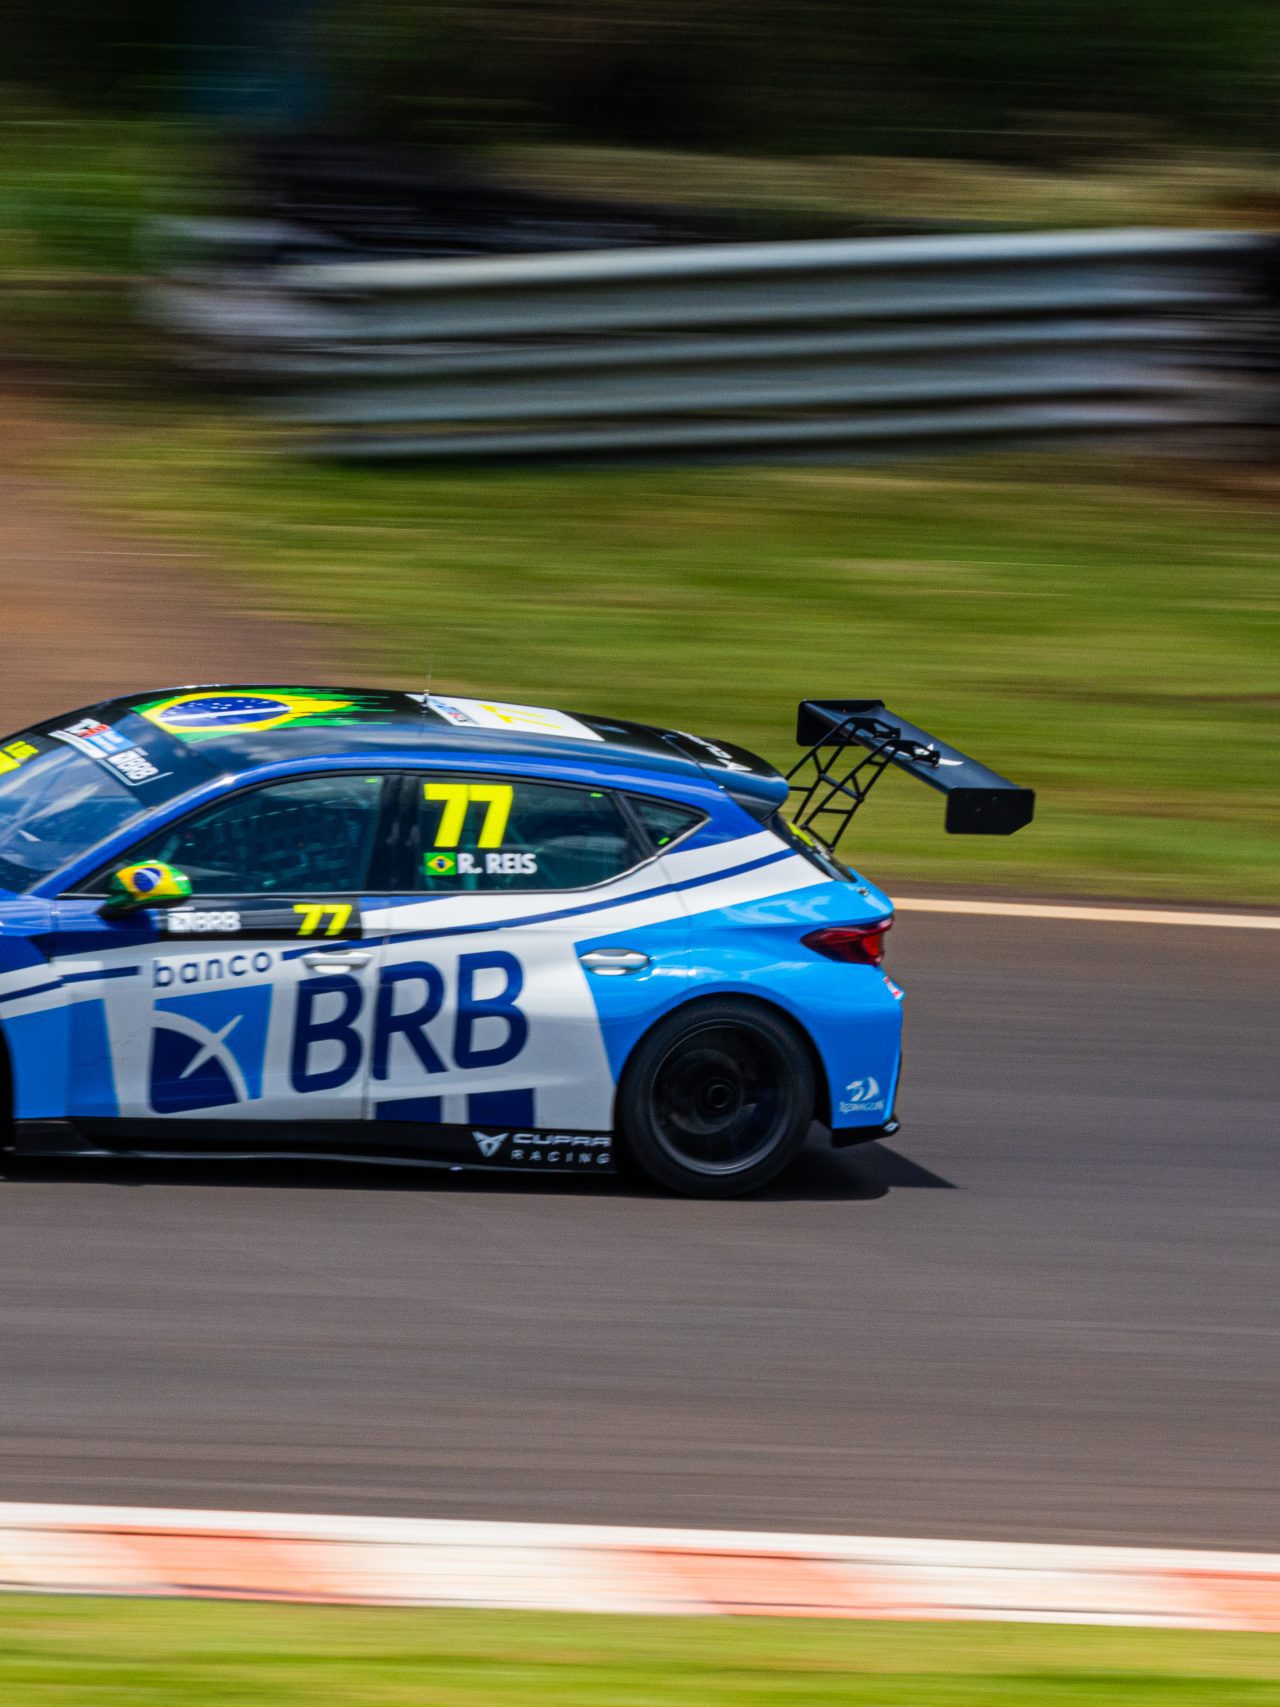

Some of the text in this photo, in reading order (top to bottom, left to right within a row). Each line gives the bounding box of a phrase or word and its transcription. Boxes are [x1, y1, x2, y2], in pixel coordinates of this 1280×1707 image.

[423, 784, 514, 849] 77
[457, 852, 538, 875] R. REIS
[191, 910, 242, 932] BRB
[292, 903, 353, 936] 77
[151, 950, 274, 989] banco
[289, 950, 529, 1094] BRB
[512, 1132, 612, 1148] CUPRA
[510, 1149, 612, 1165] RACING
